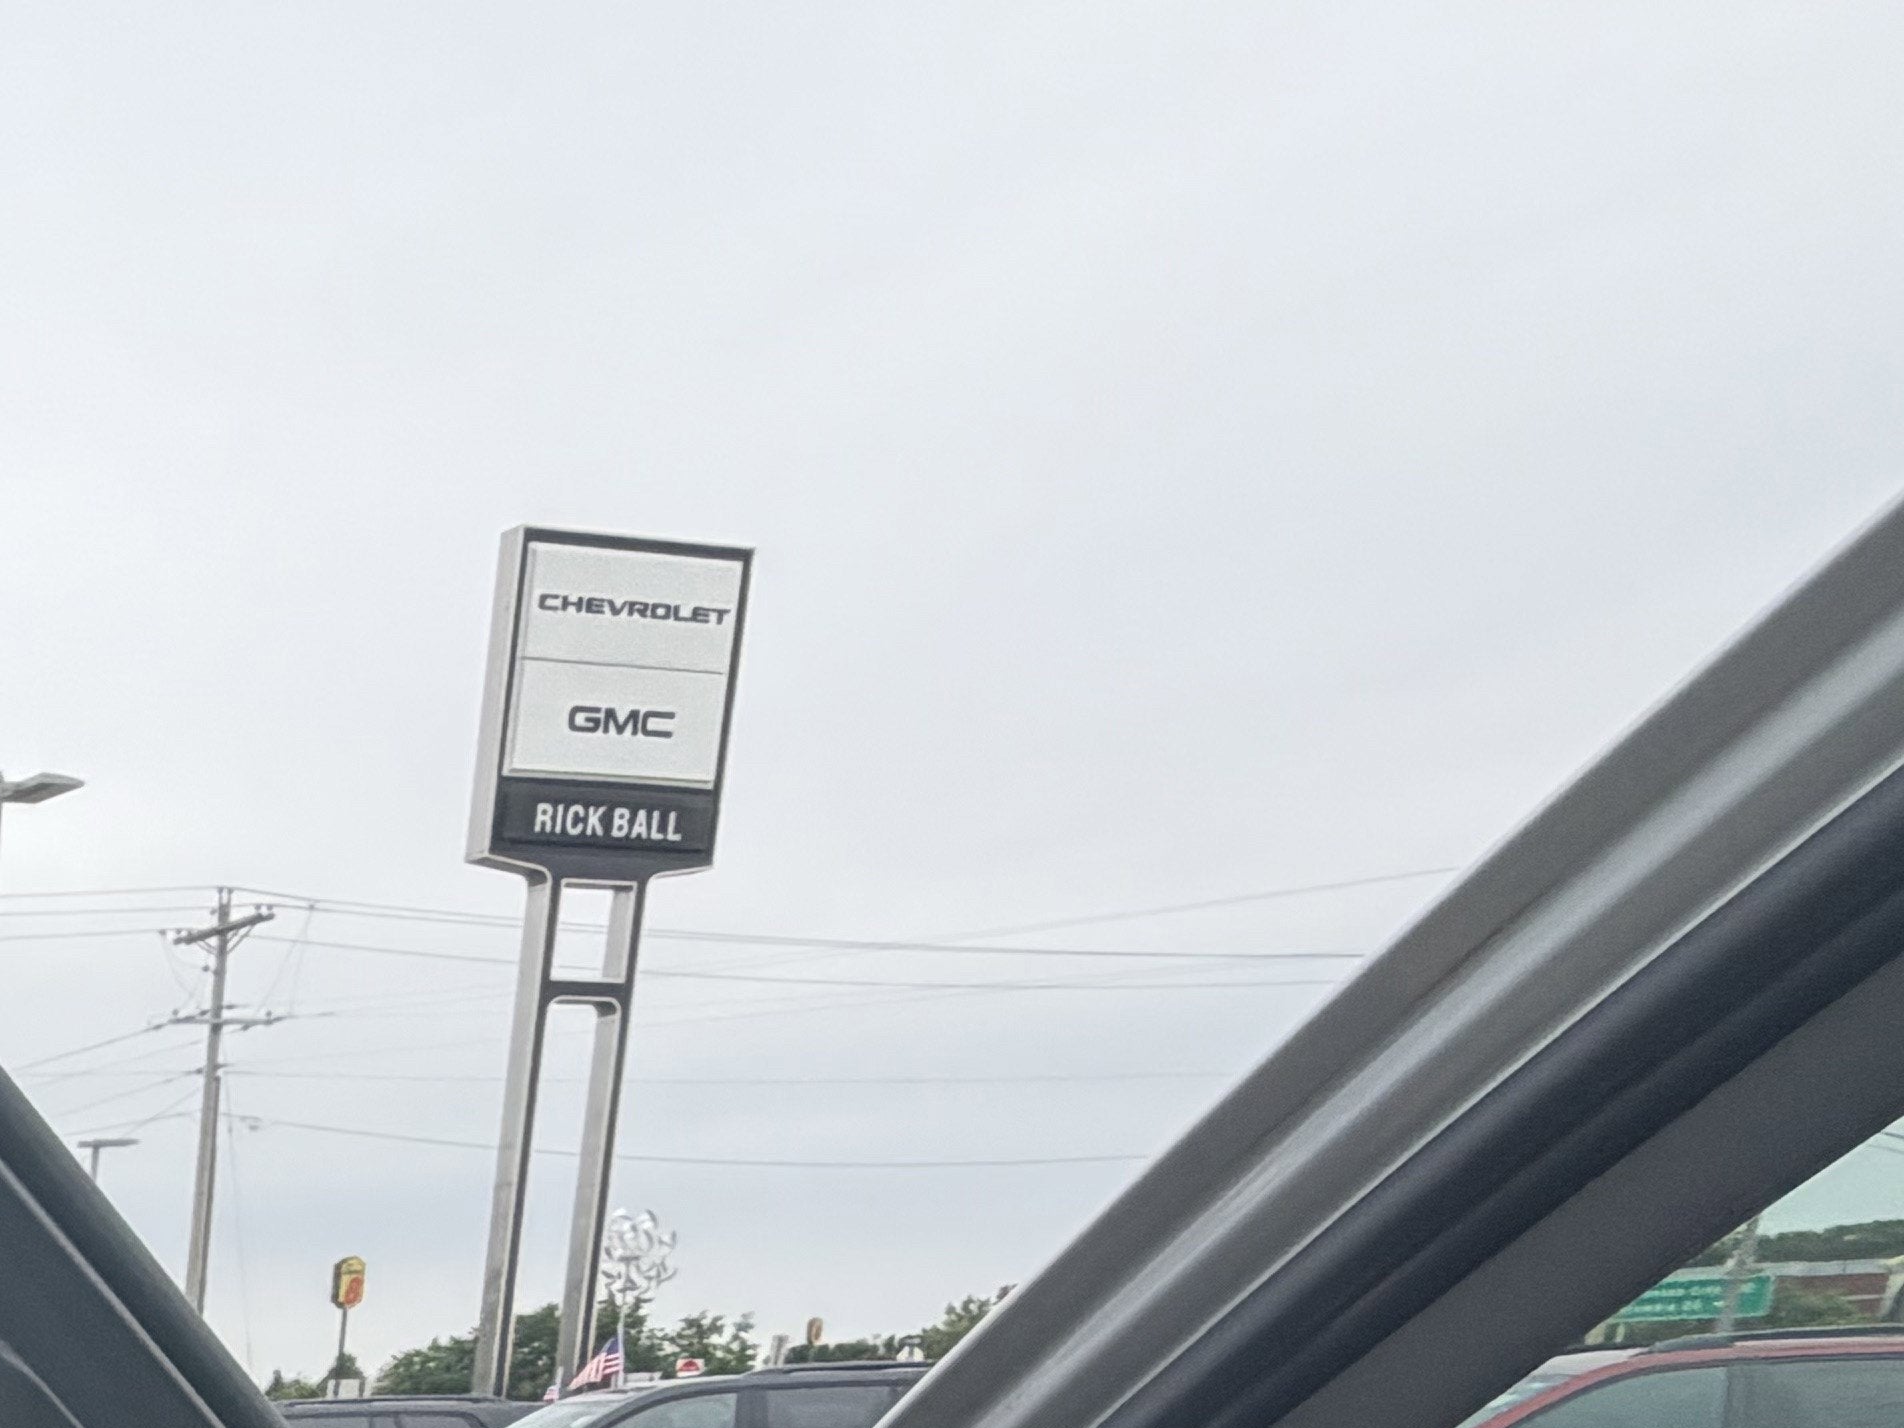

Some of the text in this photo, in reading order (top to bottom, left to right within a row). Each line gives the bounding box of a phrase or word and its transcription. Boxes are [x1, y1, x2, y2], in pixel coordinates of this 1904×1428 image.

[537, 592, 732, 626] CHEVROLET
[567, 705, 677, 739] GMC
[533, 802, 683, 842] RICK BALL
